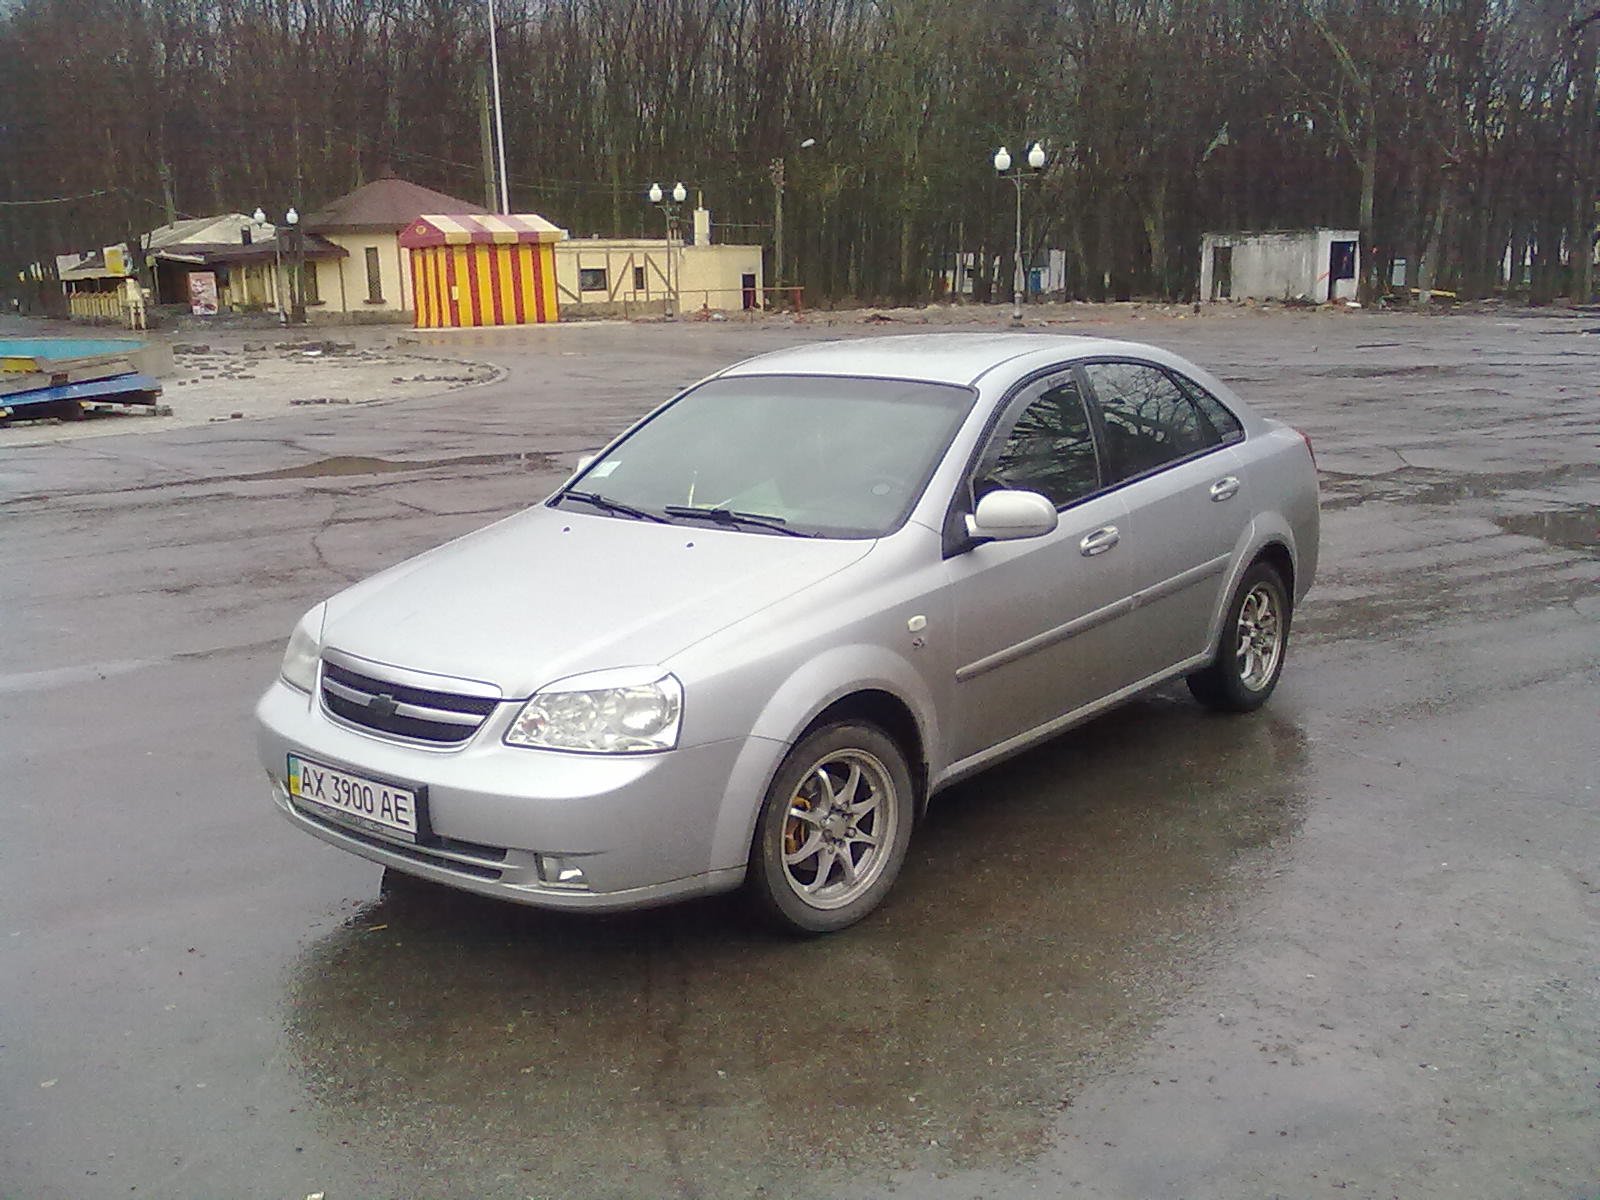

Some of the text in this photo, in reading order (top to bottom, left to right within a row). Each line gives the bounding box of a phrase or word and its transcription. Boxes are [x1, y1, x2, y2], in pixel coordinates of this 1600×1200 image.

[302, 767, 325, 799] AX
[332, 775, 374, 813] 3900
[382, 791, 409, 825] AE
